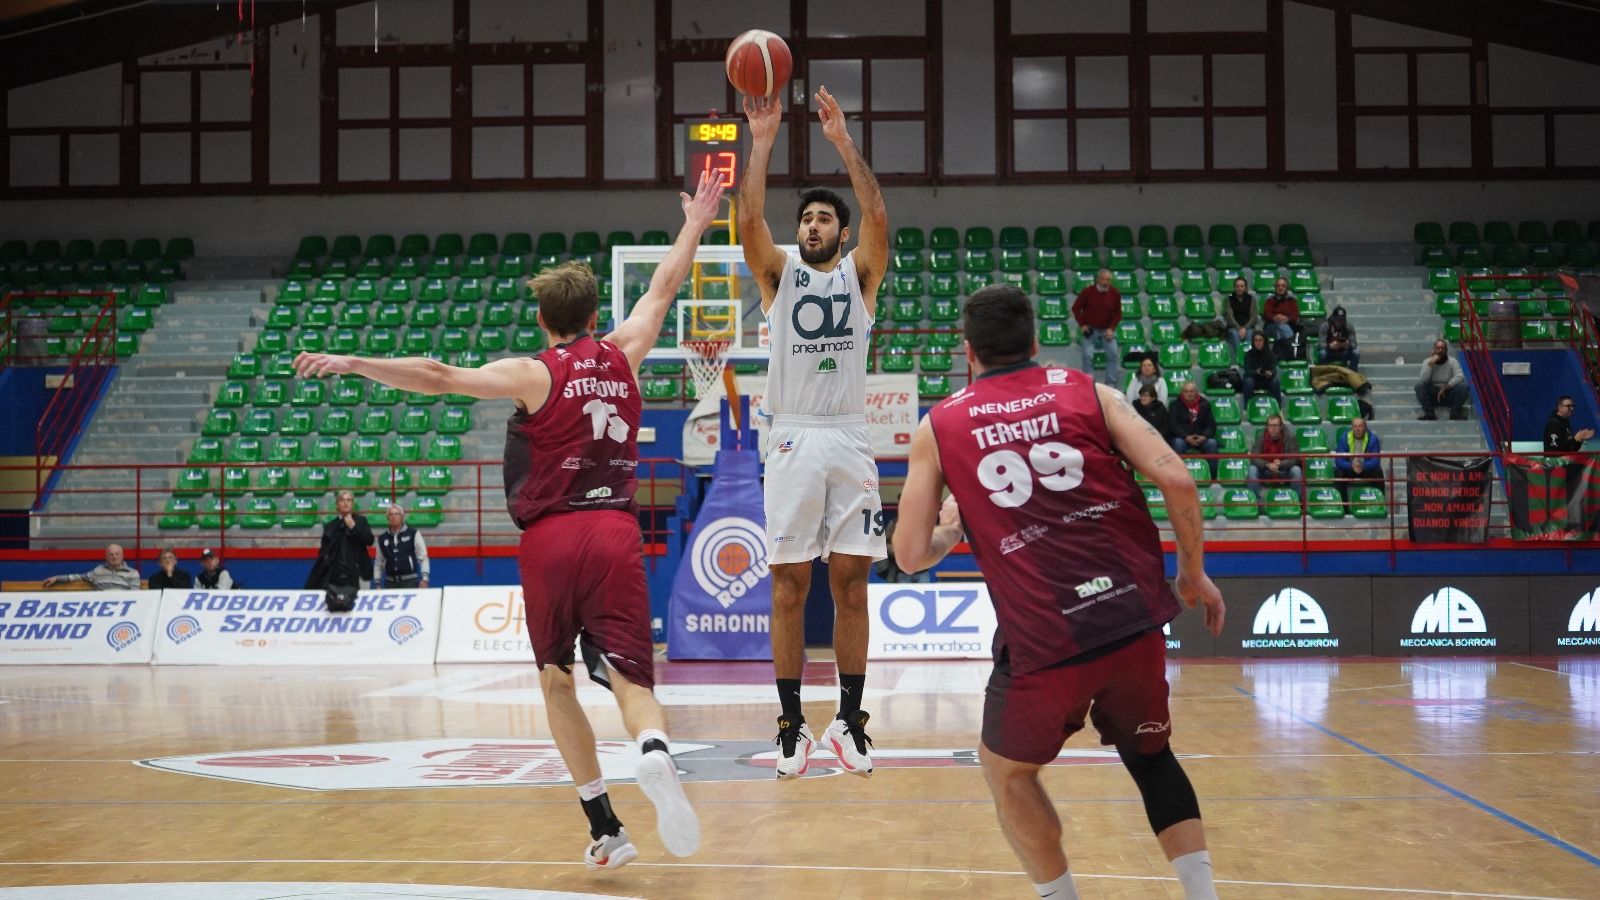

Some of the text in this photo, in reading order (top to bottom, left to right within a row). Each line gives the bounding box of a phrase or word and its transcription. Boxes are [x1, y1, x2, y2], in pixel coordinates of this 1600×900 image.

[700, 123, 737, 141] 9:49
[705, 152, 736, 187] 13
[795, 268, 810, 288] 19
[968, 393, 1056, 418] INENERGY
[971, 412, 1060, 450] TERENZI
[977, 441, 1084, 508] 99
[1453, 471, 1465, 482] LA
[862, 508, 884, 536] 19
[716, 559, 770, 609] ROBU
[14, 599, 137, 618] BASKET
[182, 592, 417, 612] ROBUR BKET
[1252, 586, 1329, 634] MB
[1411, 586, 1487, 633] MB
[1568, 586, 1600, 632] M
[219, 614, 372, 633] SARONNO
[685, 613, 770, 633] SARONN
[883, 640, 981, 652] pneumatica
[1242, 639, 1339, 648] MECCANICA BORRONI
[1400, 639, 1497, 647] MECCANICA BORRONI
